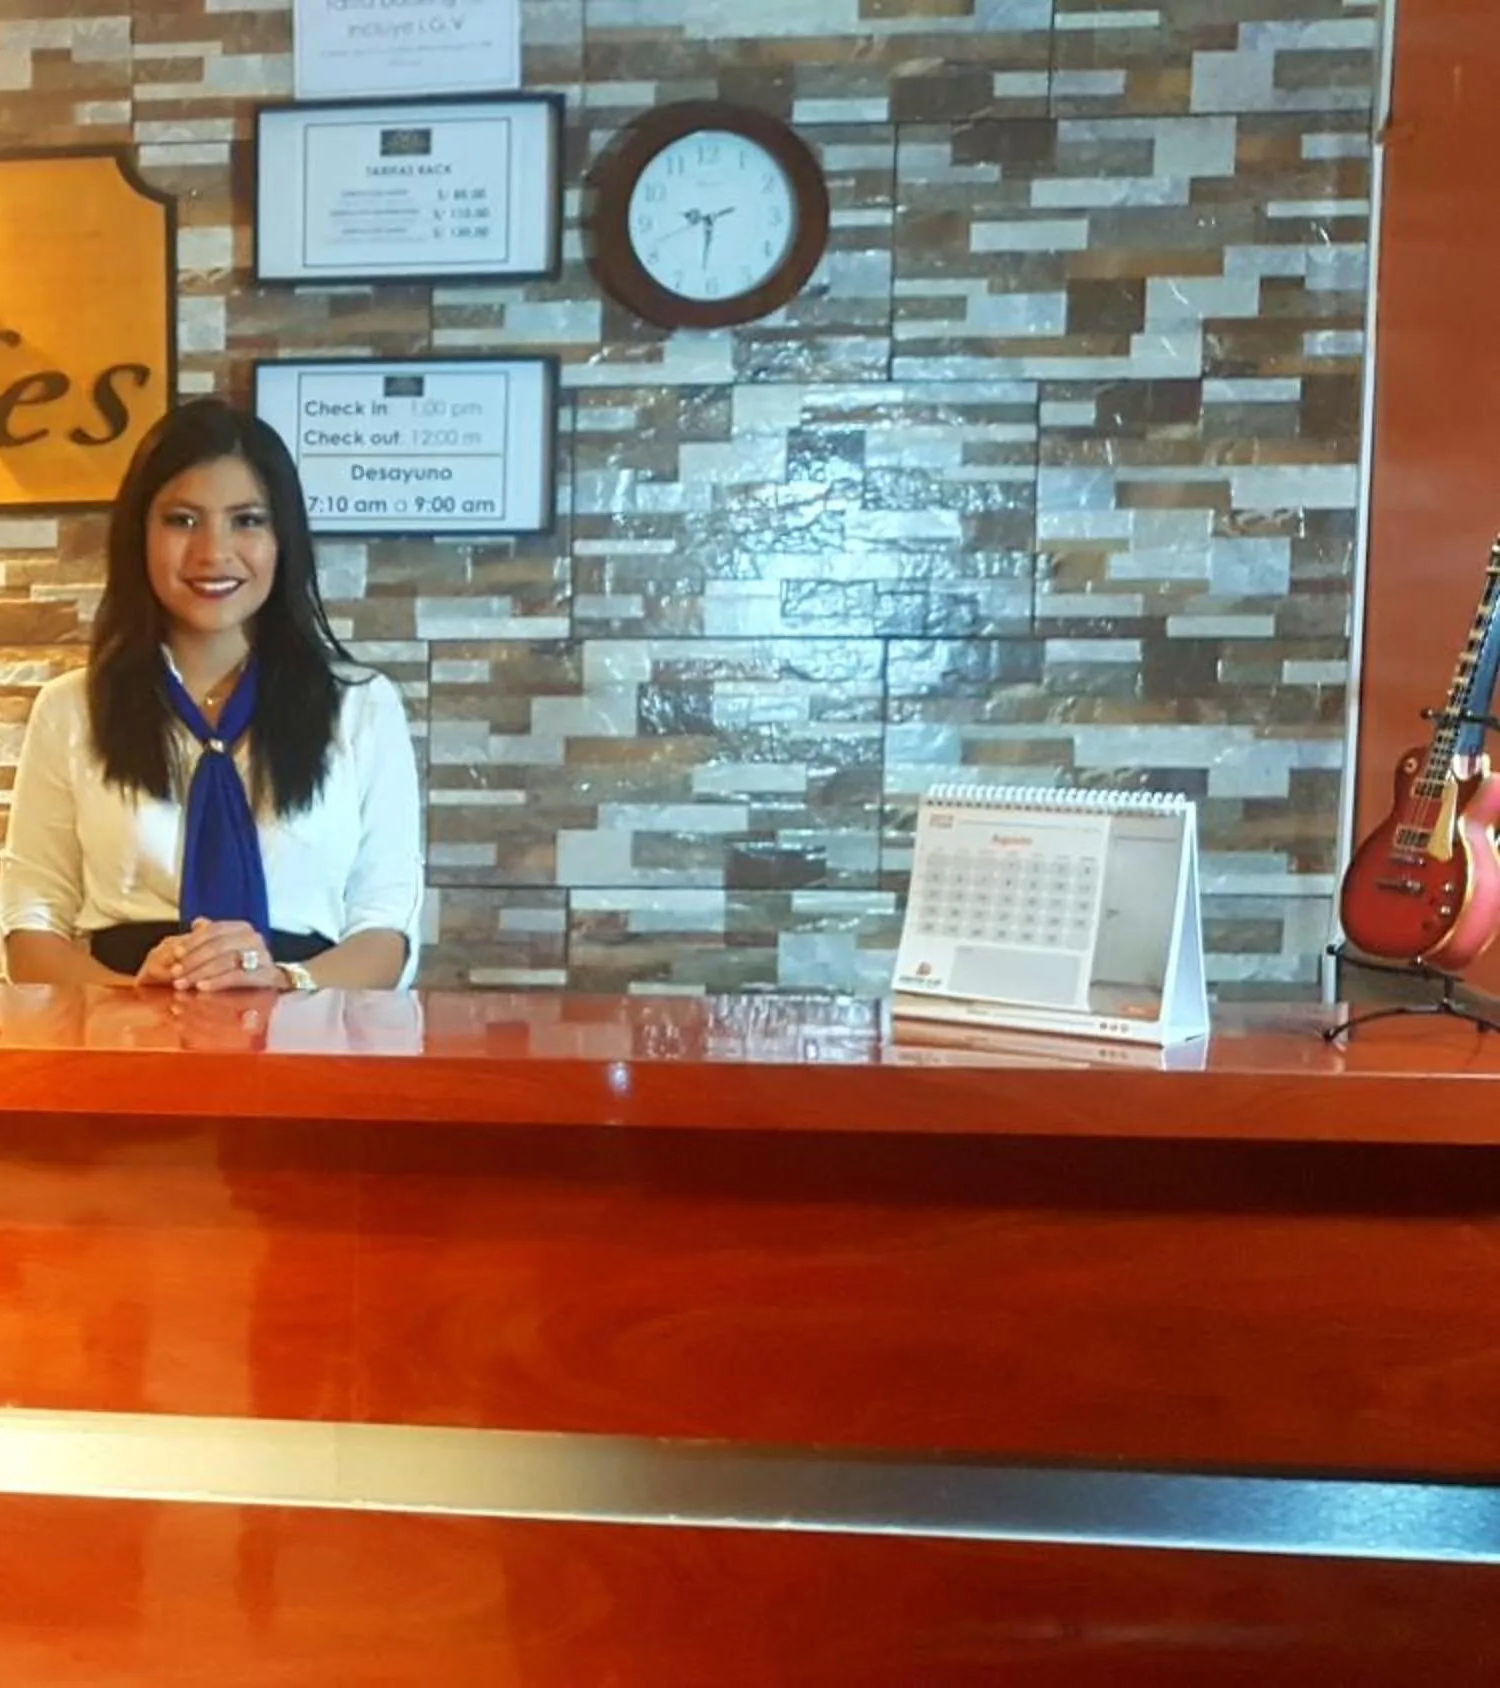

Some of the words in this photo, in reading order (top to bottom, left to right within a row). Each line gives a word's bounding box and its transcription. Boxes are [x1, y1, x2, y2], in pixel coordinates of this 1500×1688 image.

[304, 400, 364, 417] Check
[451, 403, 483, 419] pm
[303, 430, 363, 446] Check
[369, 431, 399, 445] out
[411, 429, 459, 446] 12:00
[351, 464, 453, 484] Desayuno
[308, 496, 348, 513] 7:10
[354, 500, 388, 513] am
[414, 496, 456, 513] 9:00
[461, 499, 496, 513] am
